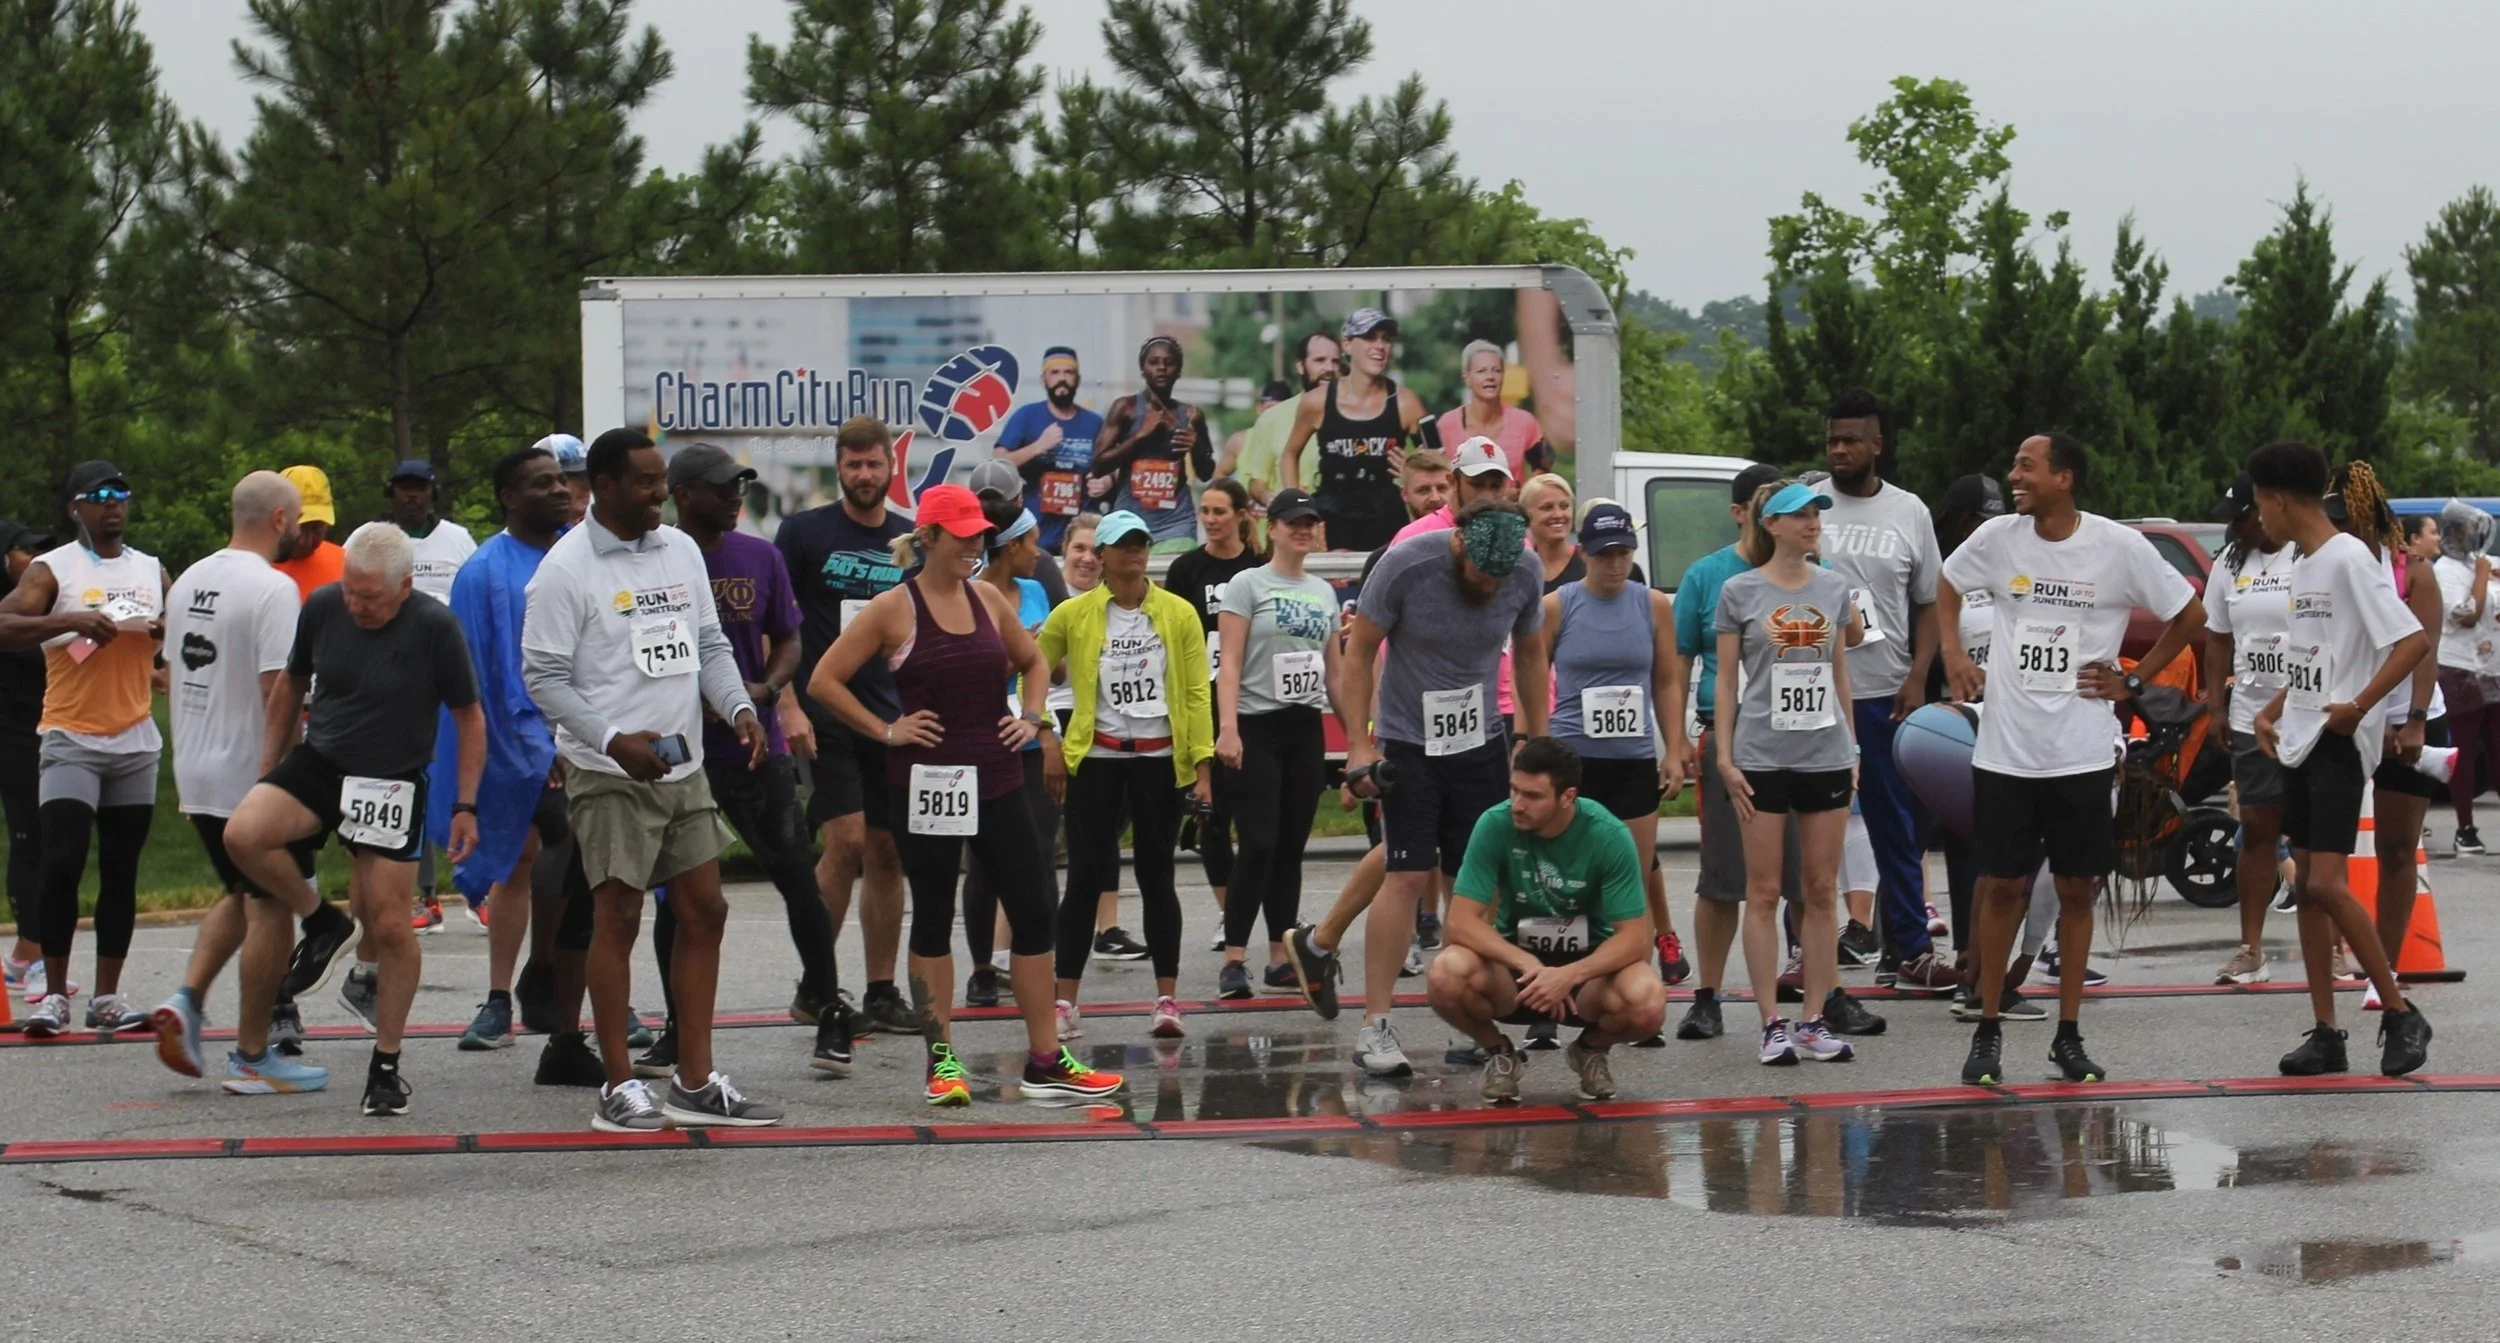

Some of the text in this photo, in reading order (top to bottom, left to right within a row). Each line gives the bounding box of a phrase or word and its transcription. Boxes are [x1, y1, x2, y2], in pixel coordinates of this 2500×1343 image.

[655, 367, 915, 429] CharmCityRun
[2033, 582, 2069, 598] RUN
[2252, 576, 2281, 587] RUN
[193, 589, 221, 608] WT
[635, 591, 669, 607] RUN
[640, 602, 691, 616] JUNETEENTH
[2032, 596, 2095, 609] JUNETEENTH
[2296, 599, 2313, 610] RUN
[1111, 639, 1143, 650] RUN
[2019, 644, 2069, 673] 5813
[1282, 671, 1319, 695] 5872
[2287, 663, 2322, 692] 5814
[1110, 678, 1157, 705] 5812
[1780, 686, 1826, 712] 5817
[1433, 707, 1477, 738] 5845
[1592, 708, 1637, 734] 5862
[351, 798, 402, 829] 5849
[919, 789, 968, 816] 5819
